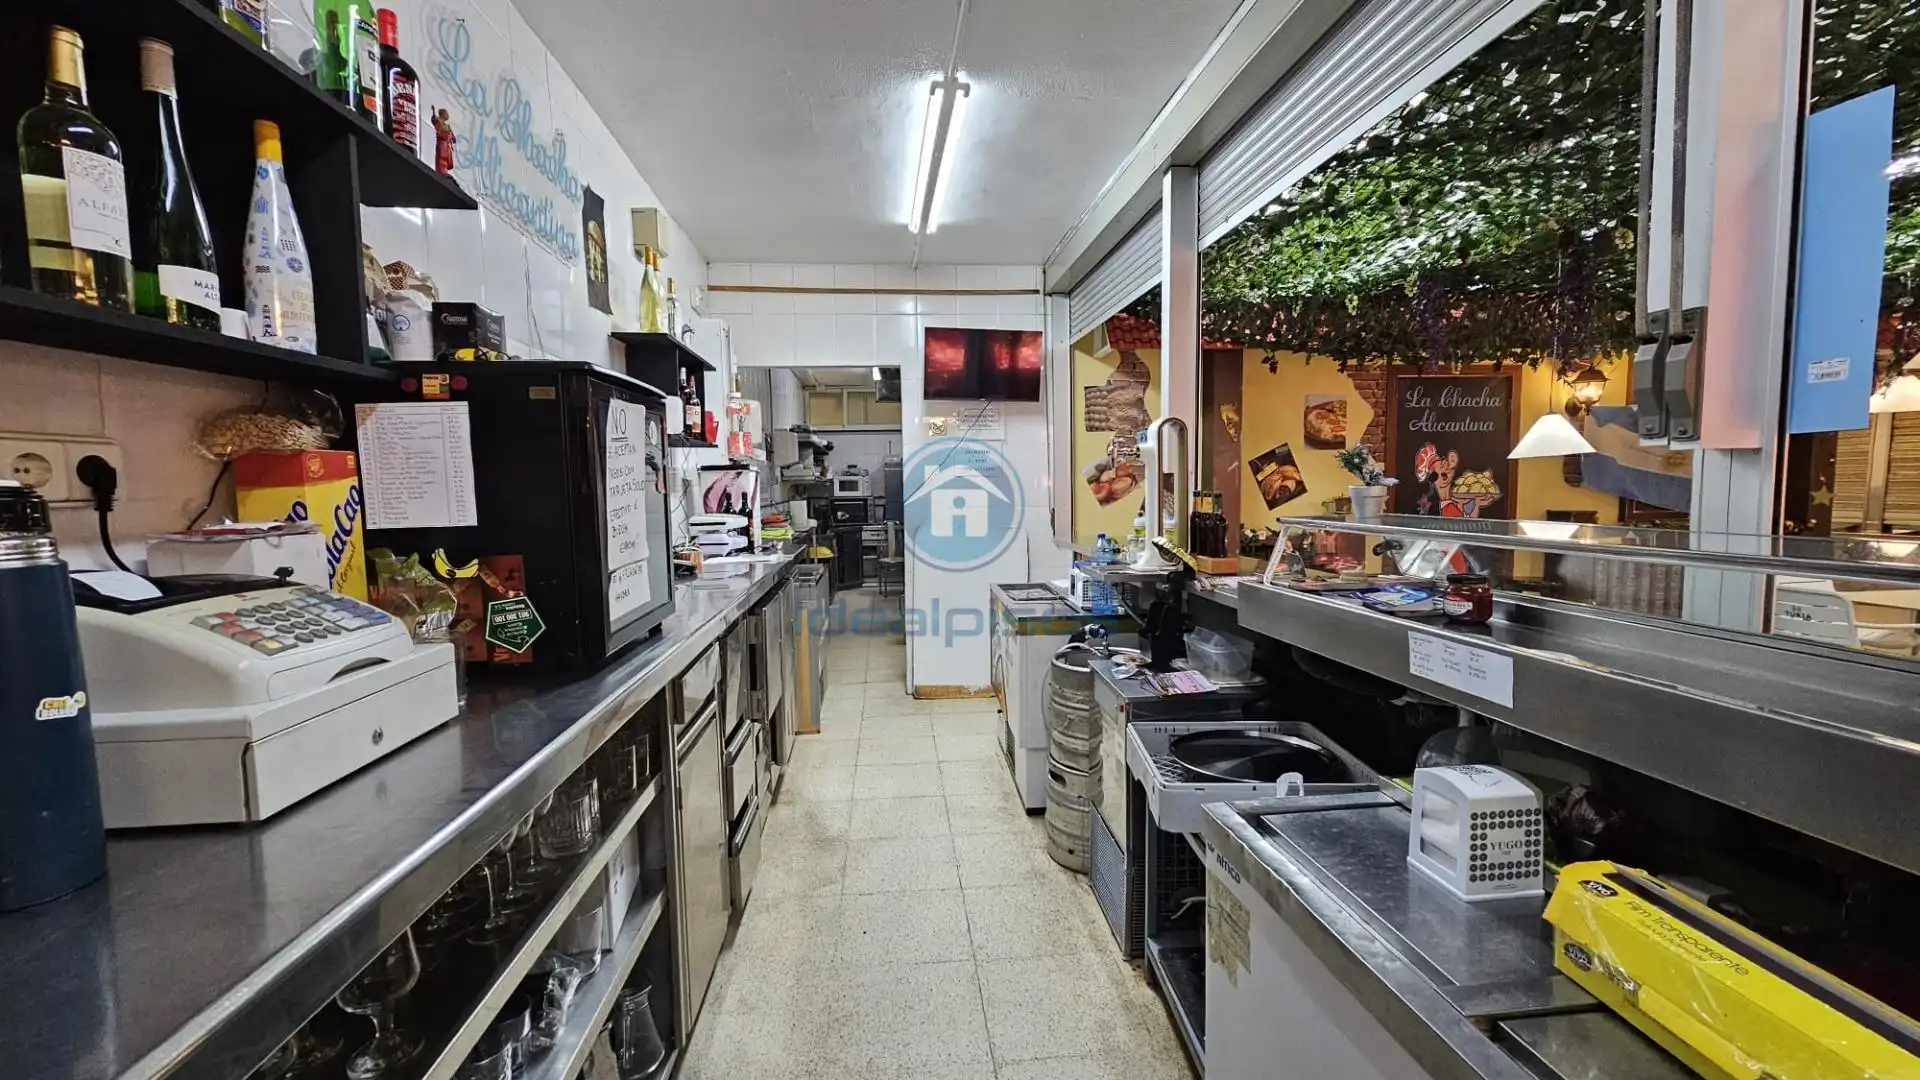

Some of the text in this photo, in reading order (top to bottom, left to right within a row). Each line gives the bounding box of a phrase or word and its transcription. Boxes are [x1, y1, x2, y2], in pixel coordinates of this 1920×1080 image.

[437, 17, 581, 204] La Chacha
[1405, 385, 1504, 409] La Chacha
[611, 404, 627, 435] NO
[1409, 409, 1496, 432] Alicantina
[1490, 839, 1523, 852] YUGO
[1651, 915, 1750, 977] Transparente
